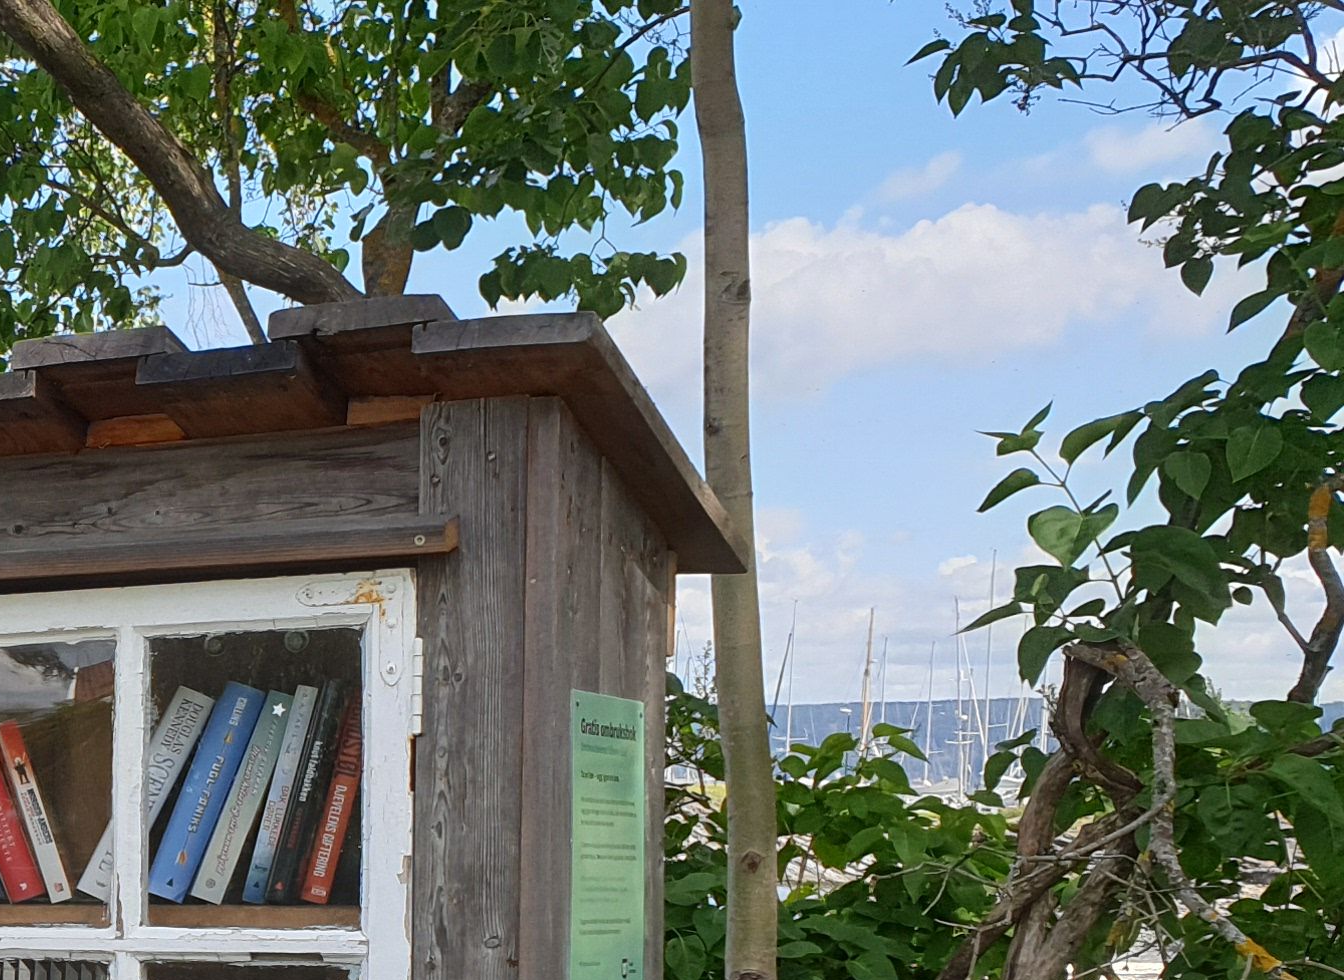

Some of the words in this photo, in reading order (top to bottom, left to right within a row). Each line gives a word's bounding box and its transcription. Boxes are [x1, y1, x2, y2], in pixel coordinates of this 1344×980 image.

[161, 697, 194, 751] KENNEDY
[171, 701, 205, 755] DOUGLAS
[580, 718, 600, 736] Gratis
[206, 755, 225, 785] FUGL
[188, 788, 211, 834] FØNIKS
[328, 784, 348, 834] DJEVELENS
[313, 832, 337, 878] GIFTERING
